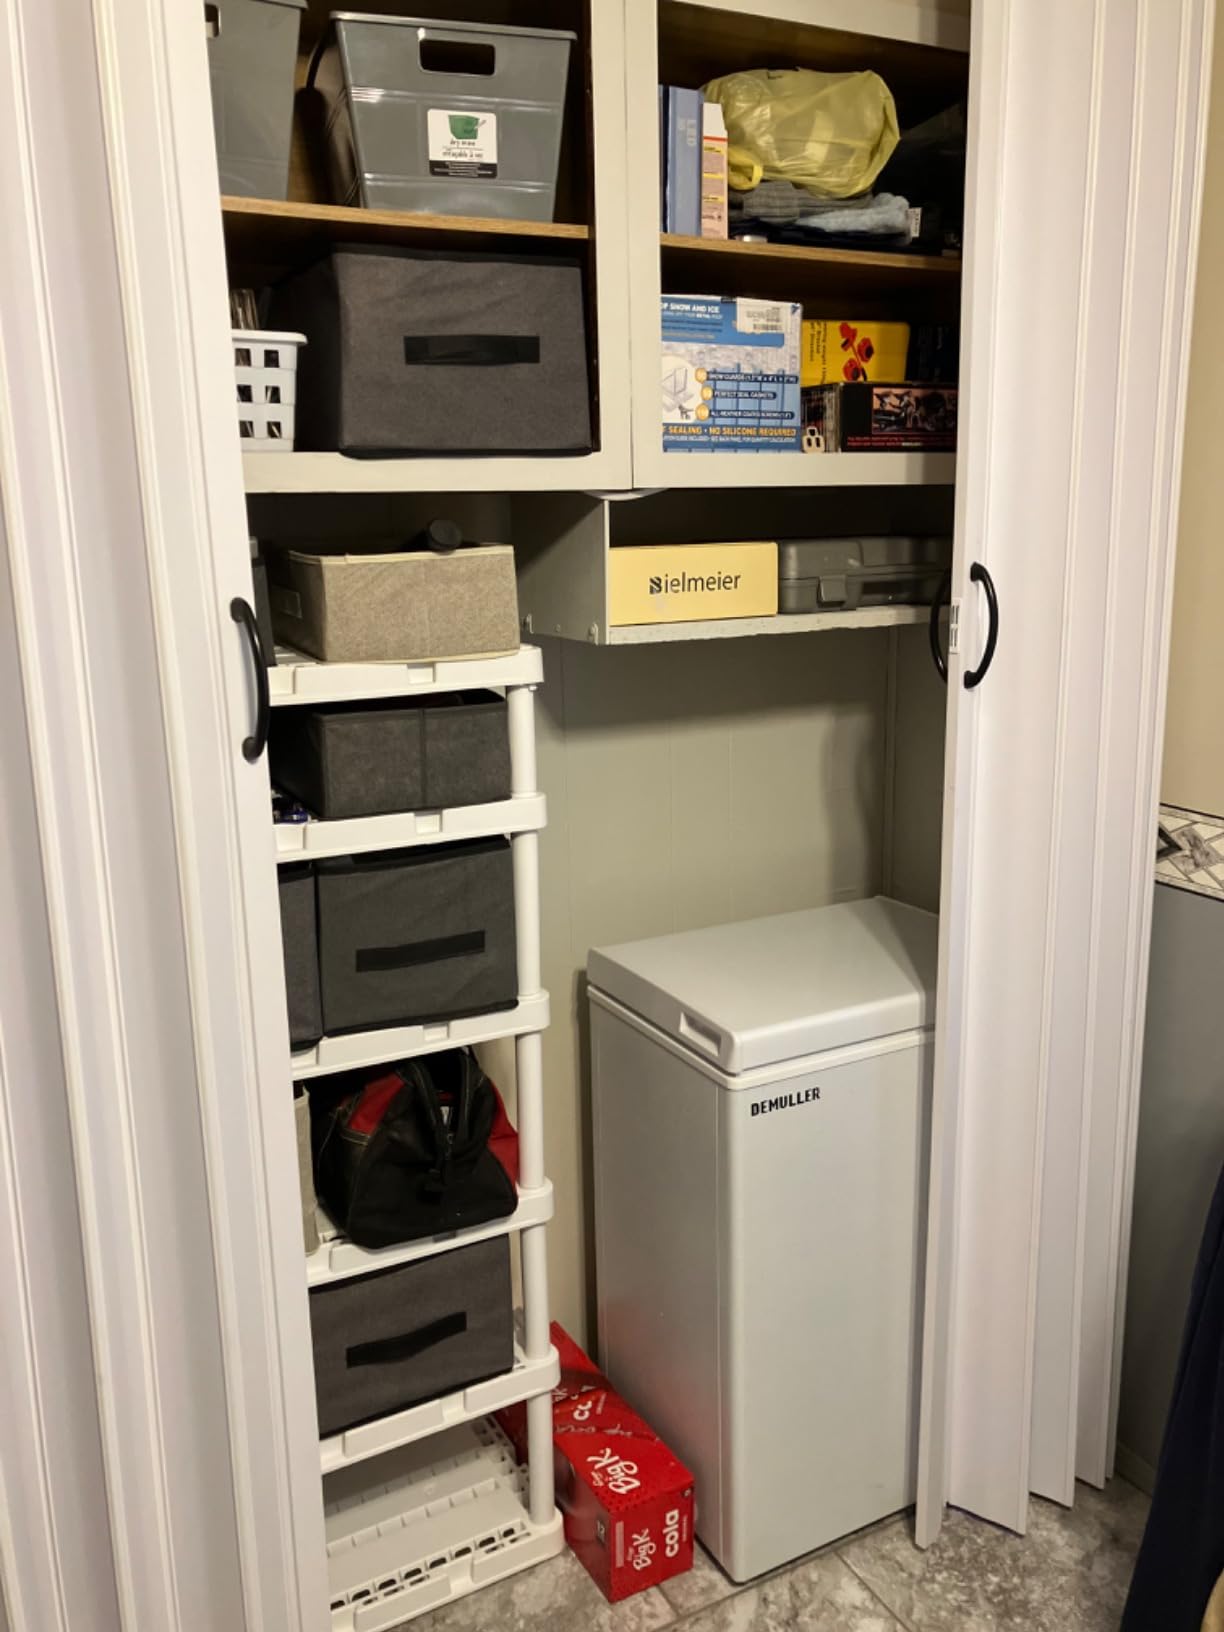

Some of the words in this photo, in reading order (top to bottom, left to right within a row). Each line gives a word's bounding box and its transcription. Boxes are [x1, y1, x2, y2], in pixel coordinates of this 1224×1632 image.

[670, 303, 691, 311] SNOW
[692, 304, 707, 312] AND
[707, 305, 720, 313] ICE
[669, 425, 702, 434] SEALING
[709, 427, 720, 435] NO
[722, 427, 756, 436] SILICONE
[759, 427, 797, 436] REQUIRED
[751, 1087, 820, 1116] DEMULLER
[662, 1509, 679, 1557] cola
